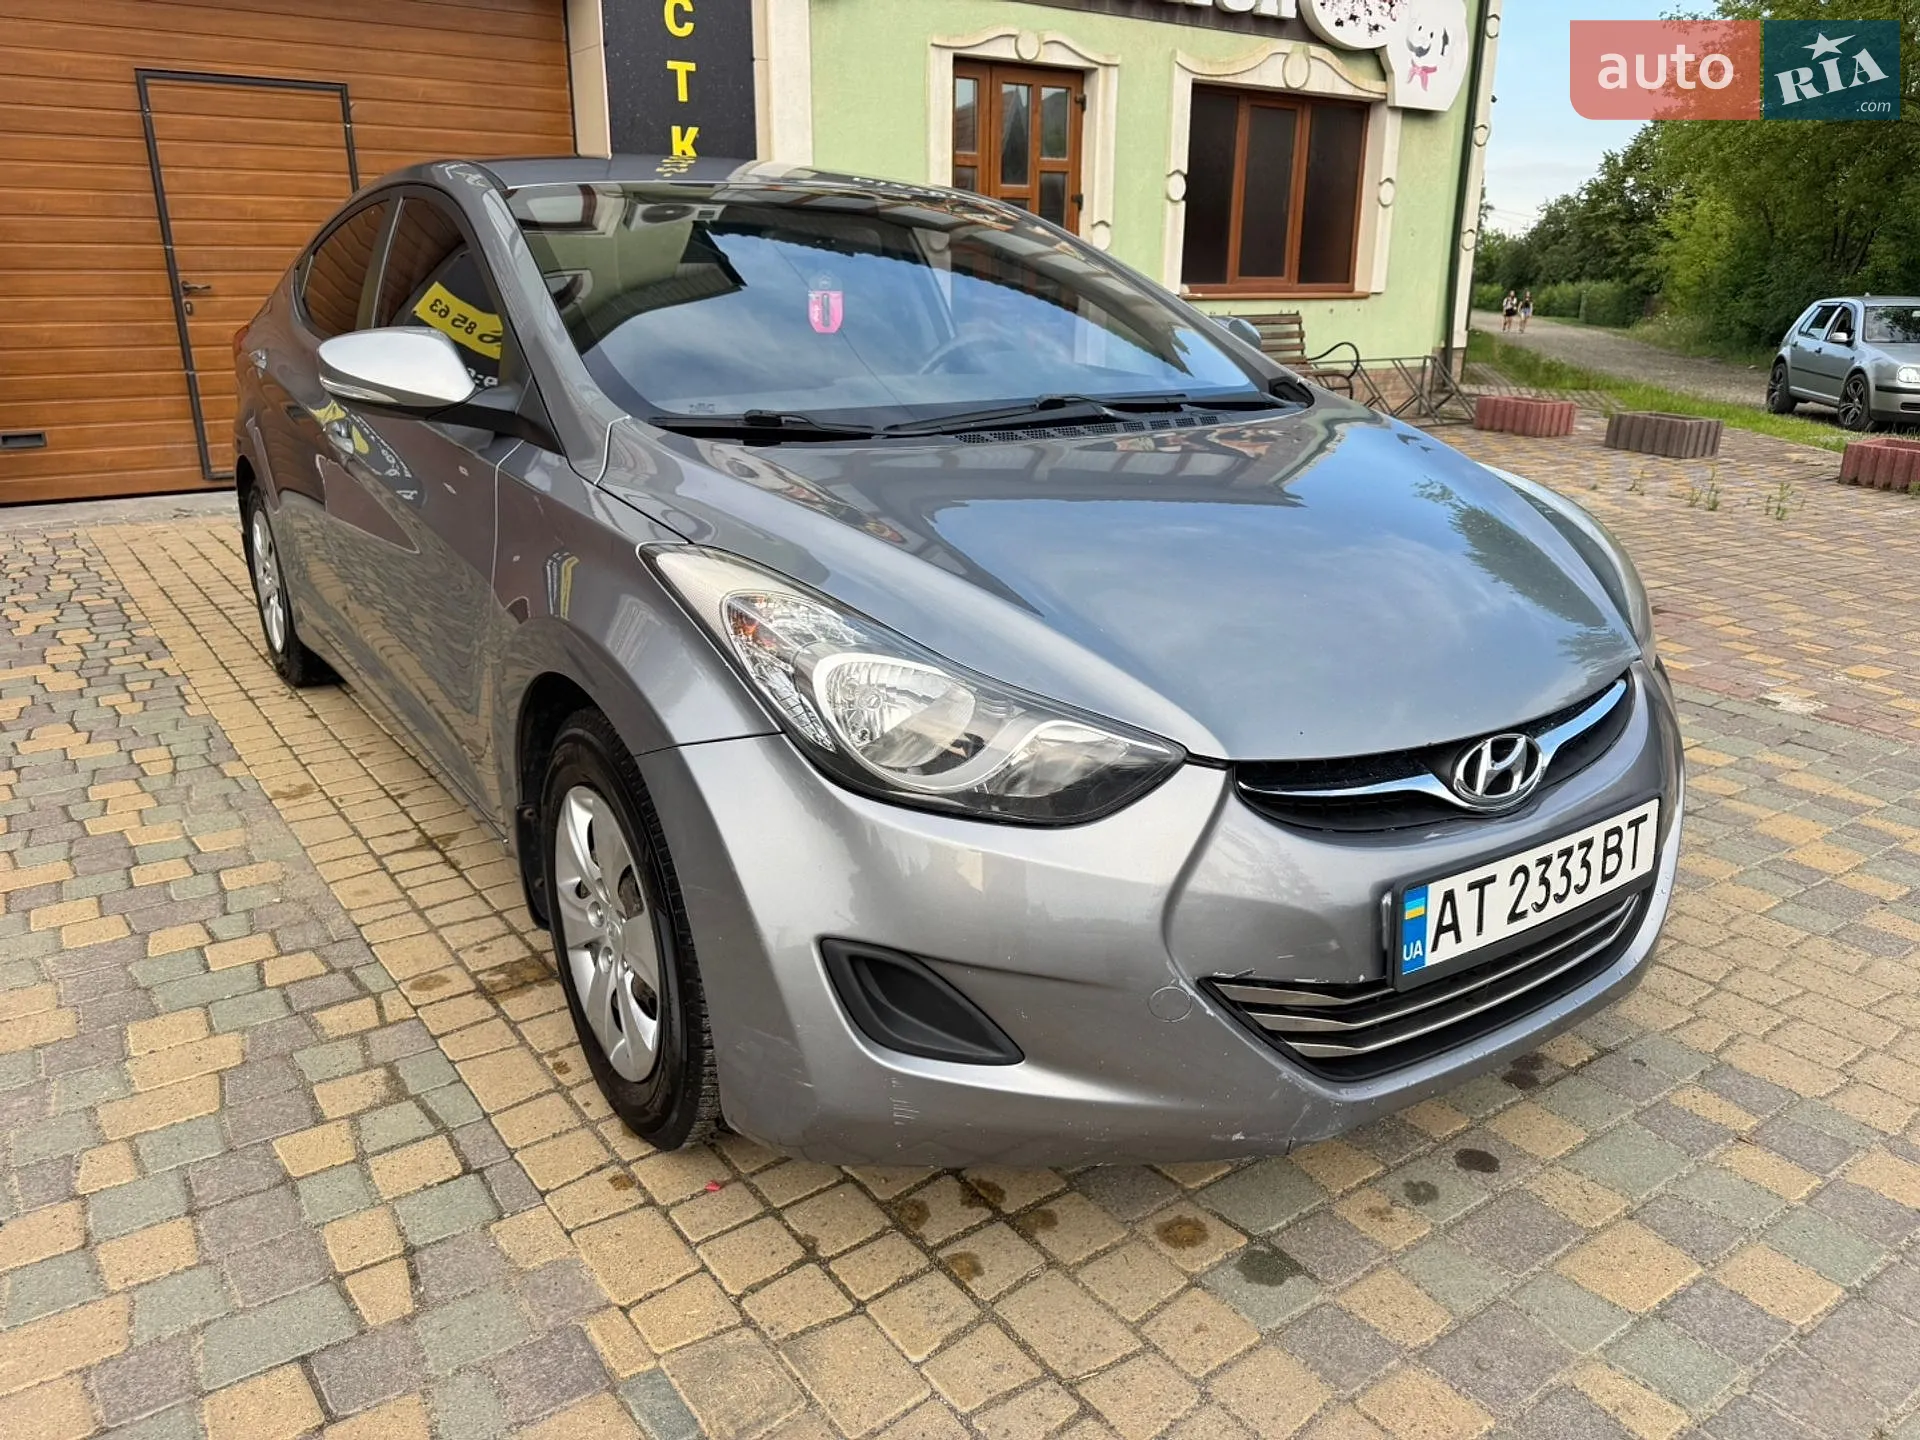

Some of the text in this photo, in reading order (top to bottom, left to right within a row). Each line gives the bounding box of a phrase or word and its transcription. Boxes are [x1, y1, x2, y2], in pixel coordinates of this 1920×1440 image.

[1431, 813, 1648, 953] AT 2333 BT
[1402, 943, 1423, 960] UA
